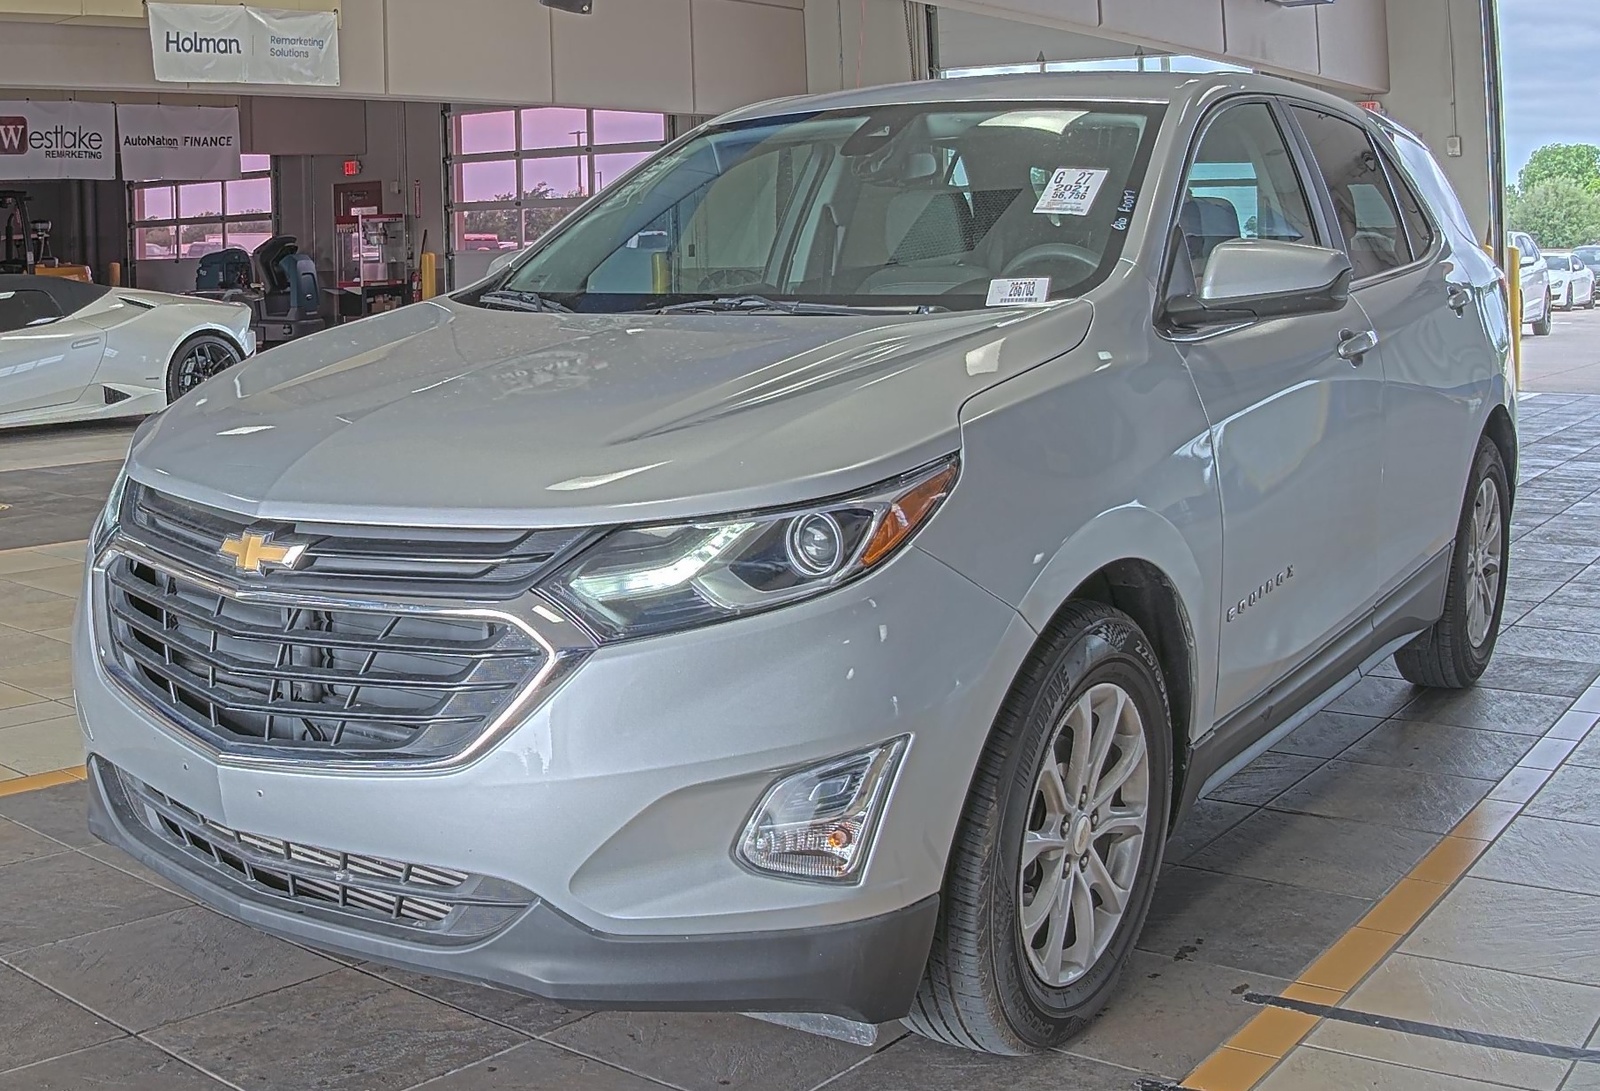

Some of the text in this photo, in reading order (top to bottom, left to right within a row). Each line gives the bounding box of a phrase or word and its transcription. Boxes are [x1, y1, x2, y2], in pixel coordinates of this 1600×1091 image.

[165, 31, 242, 54] Holman
[270, 35, 324, 49] Remarketing
[270, 48, 309, 58] Solutions
[0, 125, 103, 150] Westlake
[123, 135, 233, 147] AutoNation FINANCE
[45, 150, 102, 160] REMARKETING
[1054, 171, 1094, 185] G 27
[1053, 184, 1091, 192] 2021
[1226, 564, 1294, 622] EQUINOX
